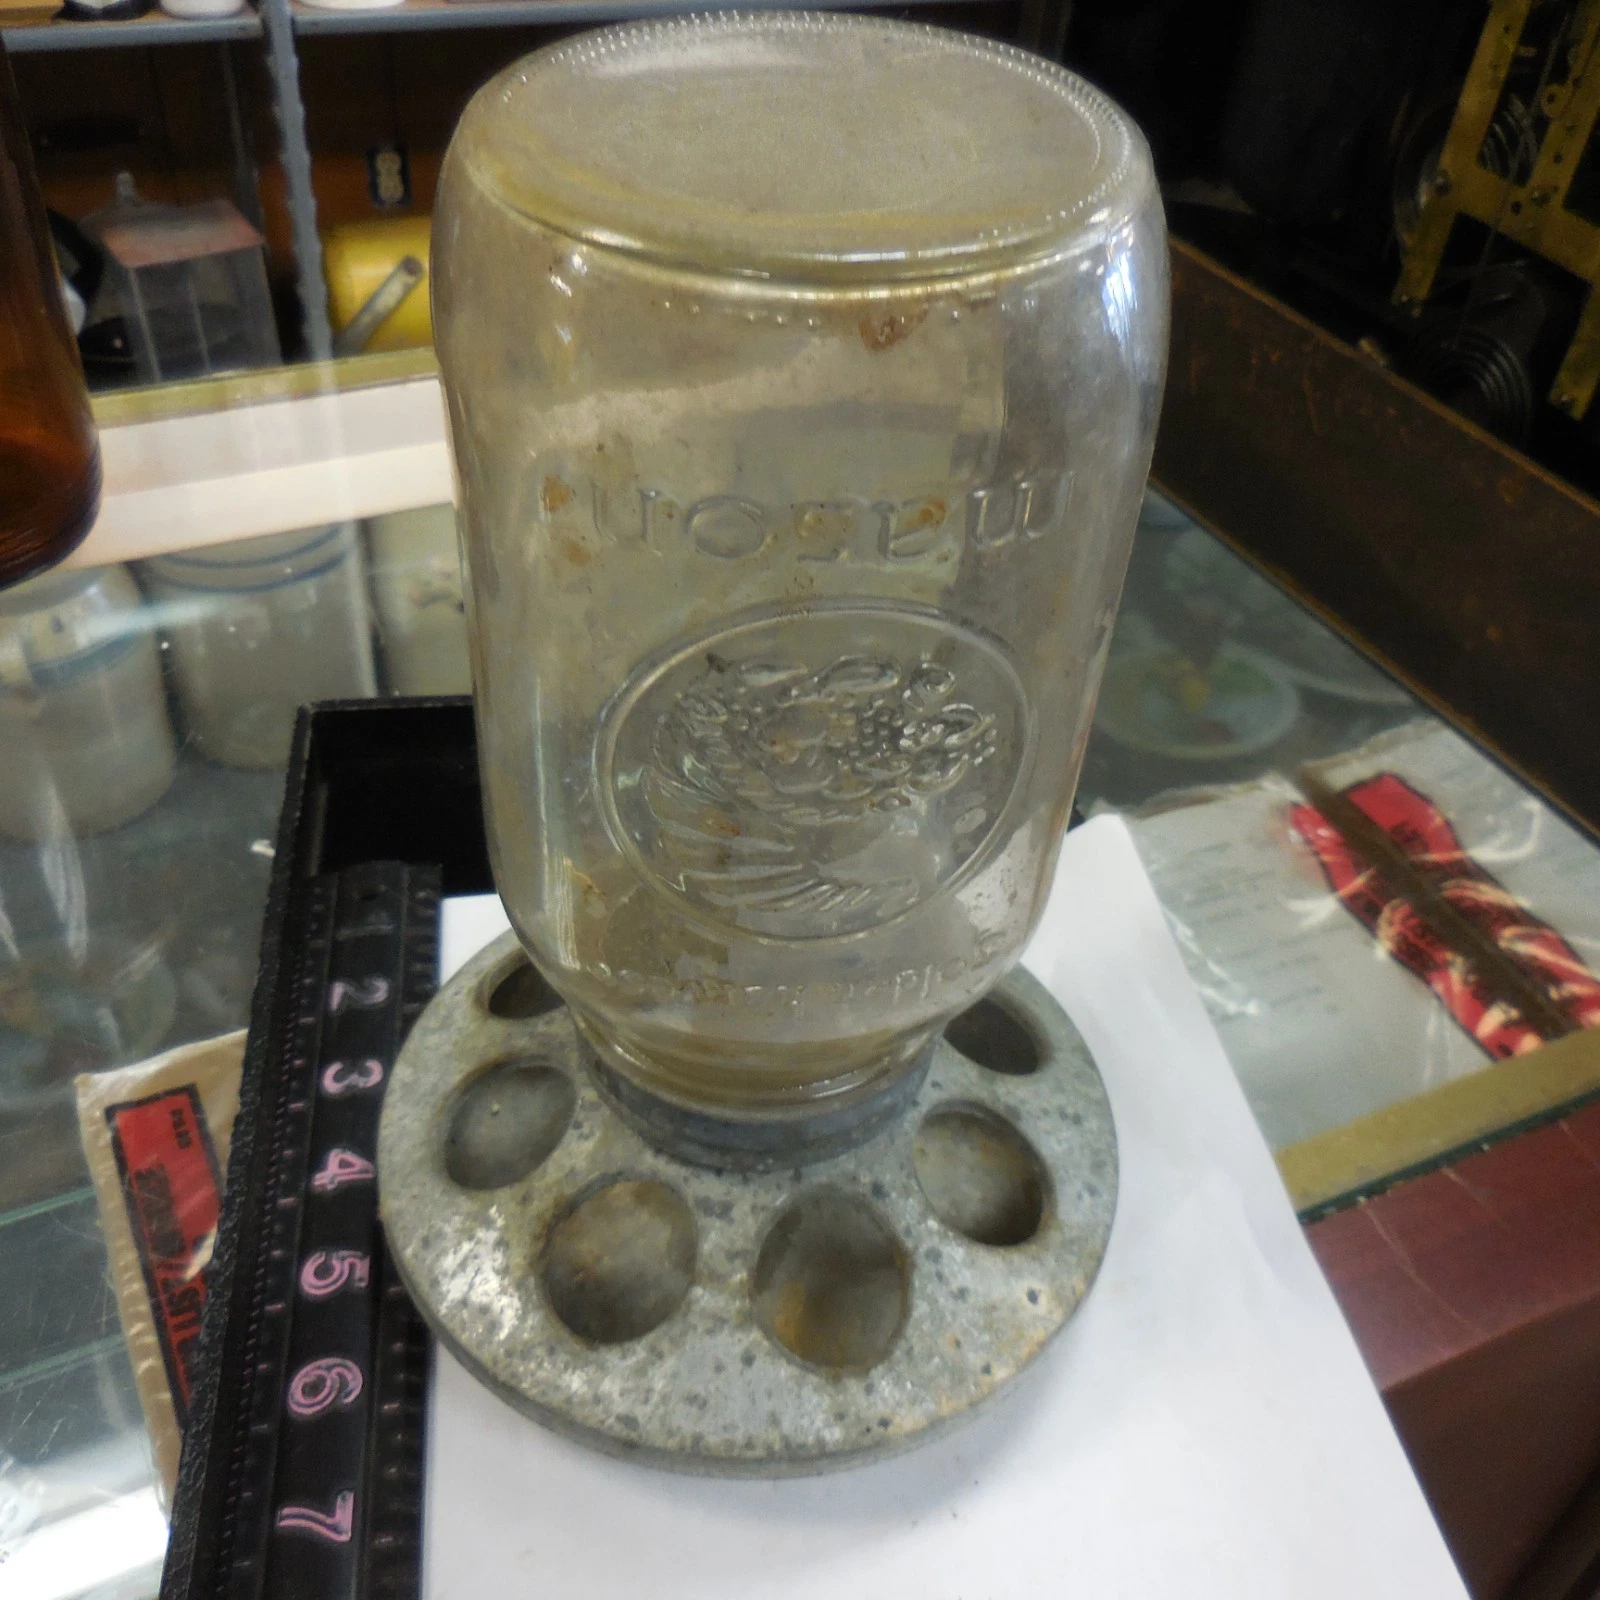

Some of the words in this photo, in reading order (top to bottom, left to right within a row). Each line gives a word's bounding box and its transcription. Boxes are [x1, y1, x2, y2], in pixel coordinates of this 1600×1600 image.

[329, 976, 389, 1012] 2
[321, 1057, 384, 1094] 3
[311, 1149, 376, 1190] 4
[300, 1250, 370, 1295] 5
[288, 1356, 363, 1415] 6
[277, 1489, 356, 1542] 7
